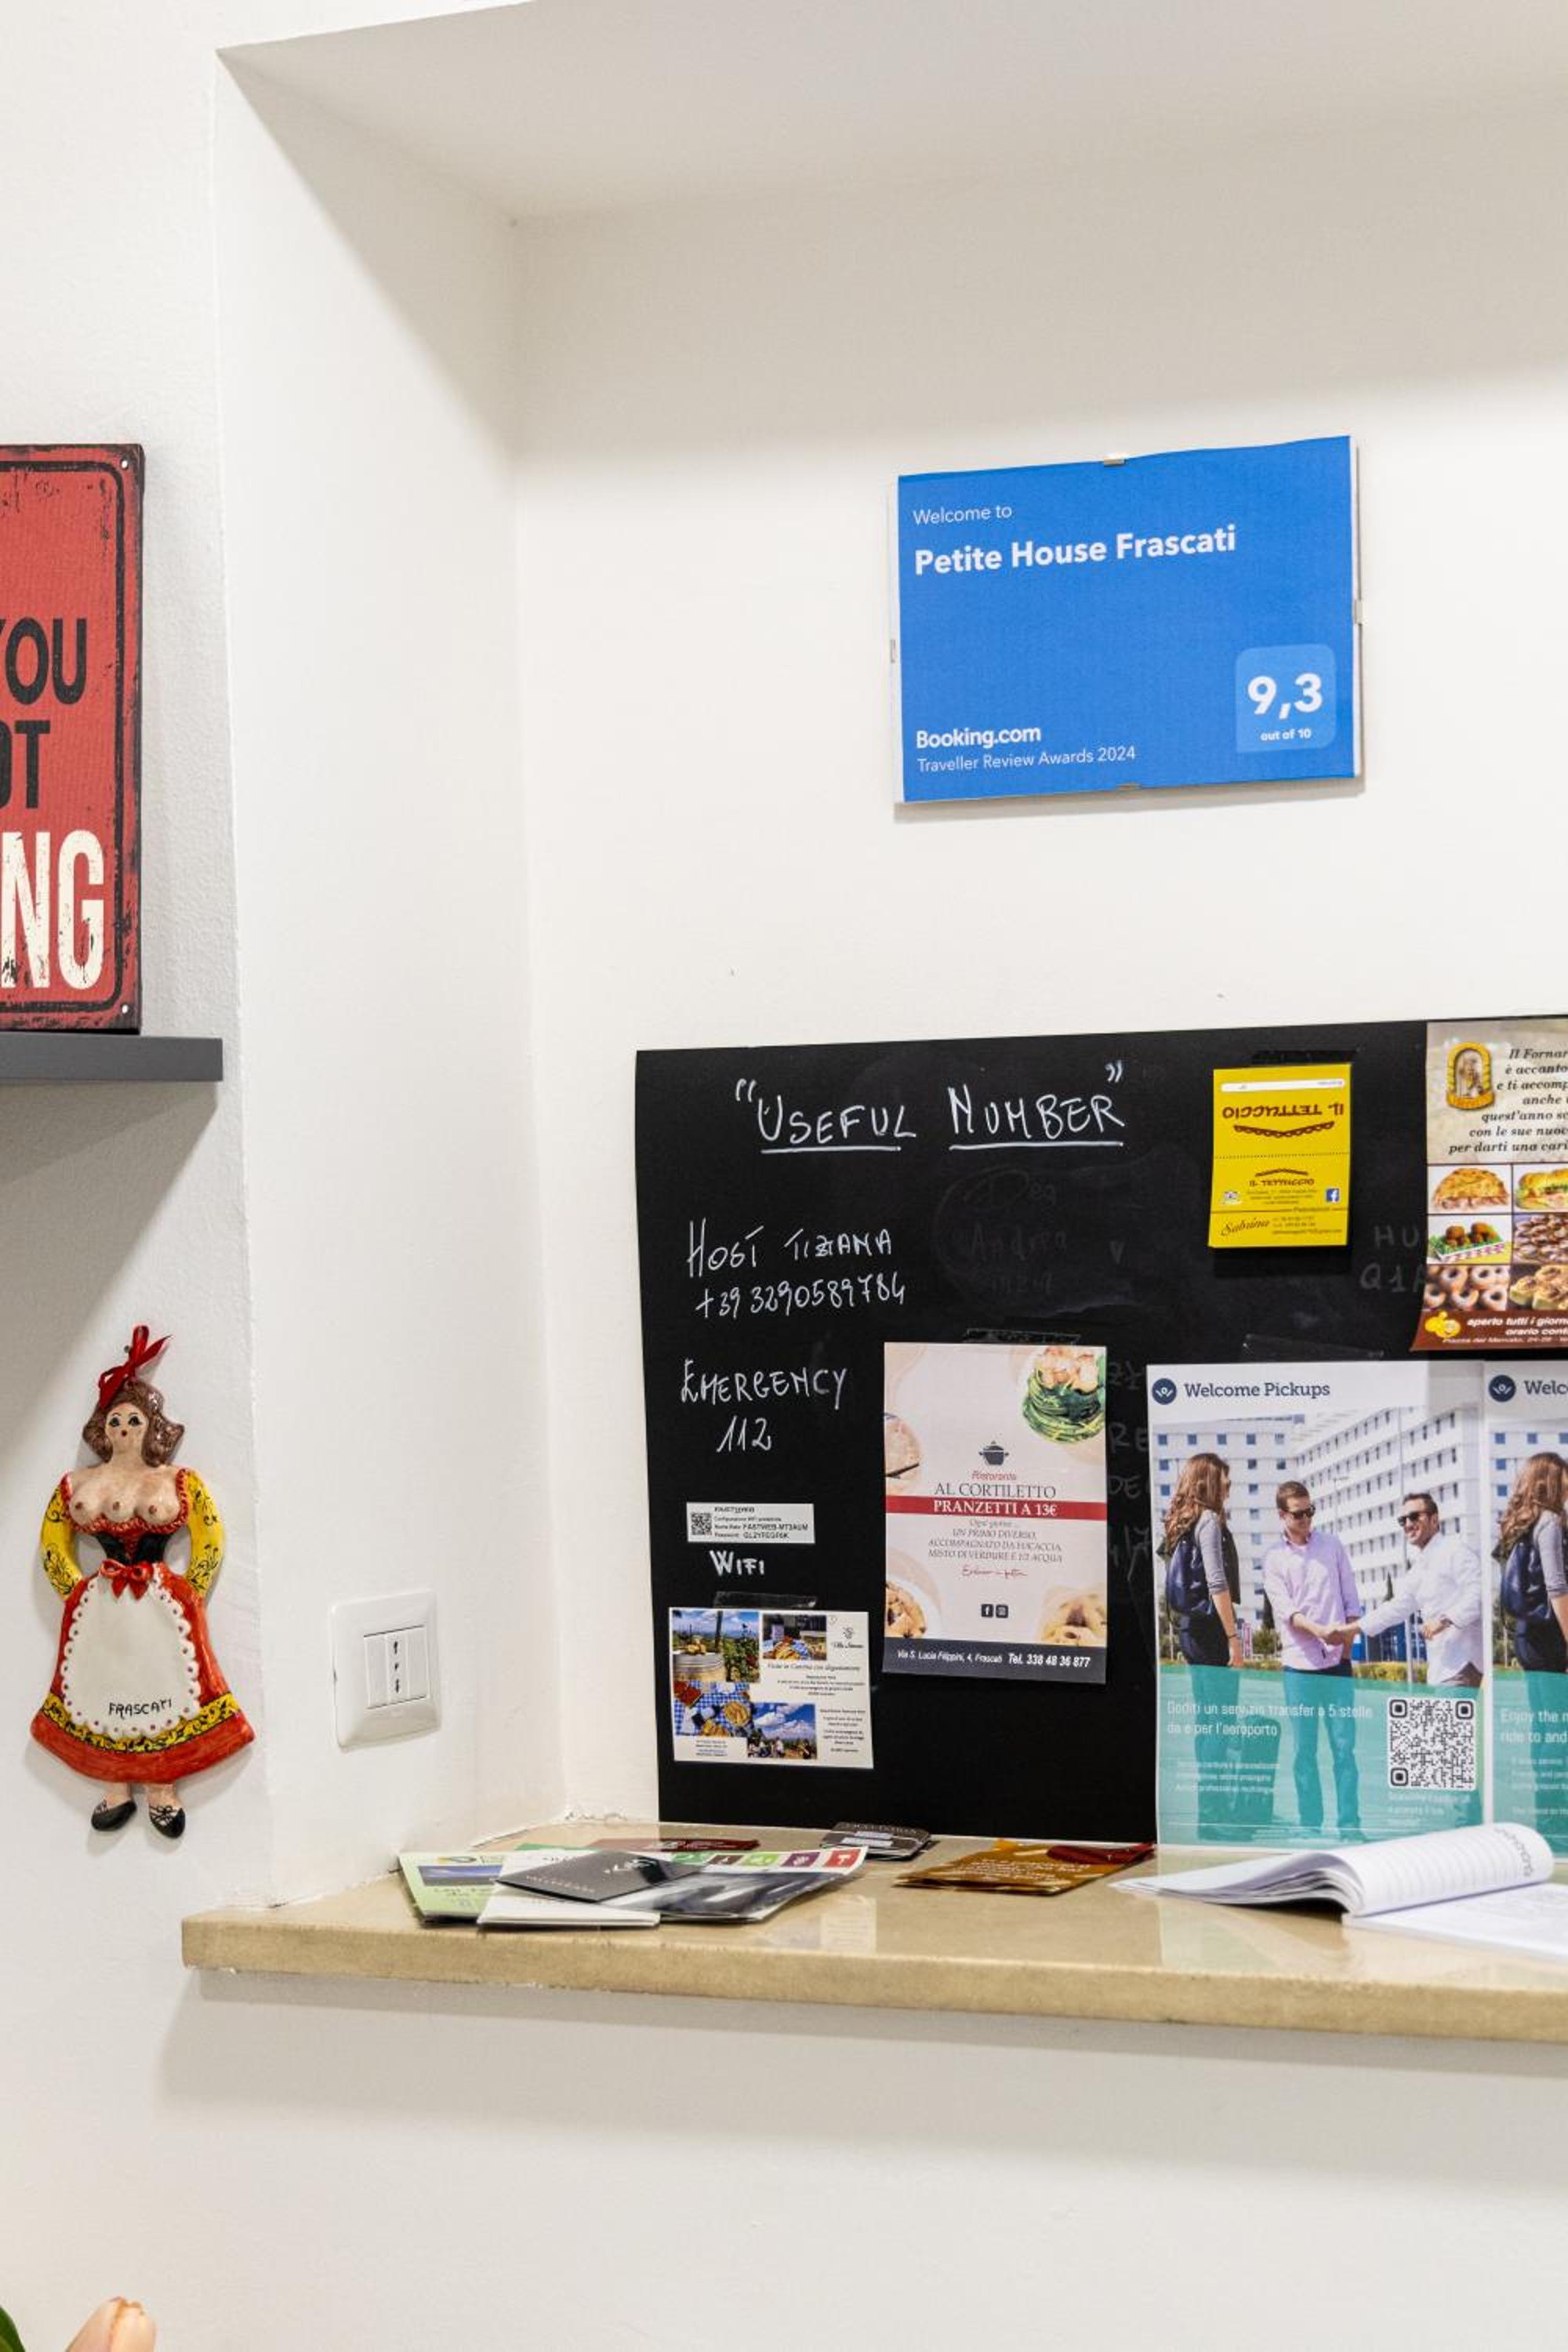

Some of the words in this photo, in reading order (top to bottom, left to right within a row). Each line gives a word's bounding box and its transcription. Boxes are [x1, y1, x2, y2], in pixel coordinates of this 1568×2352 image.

[913, 507, 990, 524] Welcome
[996, 505, 1013, 519] to
[915, 545, 1002, 575] Petite
[1011, 540, 1107, 568] House
[1116, 524, 1236, 559] Frascati
[0, 617, 87, 705] OU
[1248, 672, 1323, 720] 9,3
[916, 727, 1041, 749] Booking.com
[1260, 731, 1280, 741] out
[1282, 728, 1295, 740] of
[1298, 727, 1312, 739] 10
[917, 754, 978, 772] Traveller
[982, 751, 1034, 769] Review
[1039, 748, 1094, 766] Awards
[1098, 746, 1136, 762] 2024
[1515, 1064, 1568, 1075] accanto
[1497, 1082, 1504, 1091] e
[1507, 1080, 1518, 1091] ti
[1523, 1094, 1562, 1105] anche
[1222, 1104, 1323, 1120] TETTUCCIO
[1481, 1111, 1553, 1123] quest'anno
[1469, 1129, 1492, 1138] con
[1496, 1126, 1508, 1137] le
[1511, 1127, 1533, 1137] sue
[1448, 1145, 1472, 1155] per
[1474, 1142, 1508, 1152] darti
[1512, 1144, 1538, 1152] una
[687, 1218, 764, 1278] HOST
[695, 1287, 740, 1319] +39
[750, 1272, 906, 1316] 3290589784
[1467, 1316, 1504, 1327] aperto
[1506, 1316, 1528, 1327] tutti
[681, 1357, 848, 1410] EMERGENCY
[1184, 1382, 1260, 1398] Welcome
[1264, 1381, 1330, 1400] Pickups
[1523, 1379, 1568, 1395] Welc
[716, 1415, 772, 1453] 112
[935, 1483, 955, 1496] AL
[959, 1483, 1057, 1498] CORTILETTO
[933, 1499, 1017, 1515] PRANZETTI
[1021, 1503, 1032, 1515] A
[1035, 1503, 1058, 1517] 13€
[967, 1530, 996, 1538] PRIMO
[928, 1548, 956, 1558] MISTO
[967, 1550, 1010, 1560] VERDURE
[1030, 1552, 1062, 1563] ACQUA
[918, 1650, 937, 1660] Lucia
[1008, 1652, 1022, 1664] Tel.
[1026, 1653, 1044, 1666] 338
[1045, 1654, 1058, 1666] 48
[1059, 1655, 1072, 1667] 36
[1073, 1656, 1091, 1668] 877
[108, 1697, 172, 1720] FRASCATI
[1203, 1704, 1218, 1715] un
[1221, 1704, 1265, 1717] servizio
[1268, 1704, 1315, 1717] transfer
[1317, 1708, 1325, 1717] a
[1328, 1704, 1338, 1718] 5
[1339, 1704, 1373, 1719] stelle
[1501, 1708, 1534, 1724] Enjoy
[1537, 1709, 1559, 1722] the
[1195, 1725, 1213, 1736] per
[1216, 1722, 1278, 1738] l'aeroporto
[1544, 1731, 1567, 1744] and
